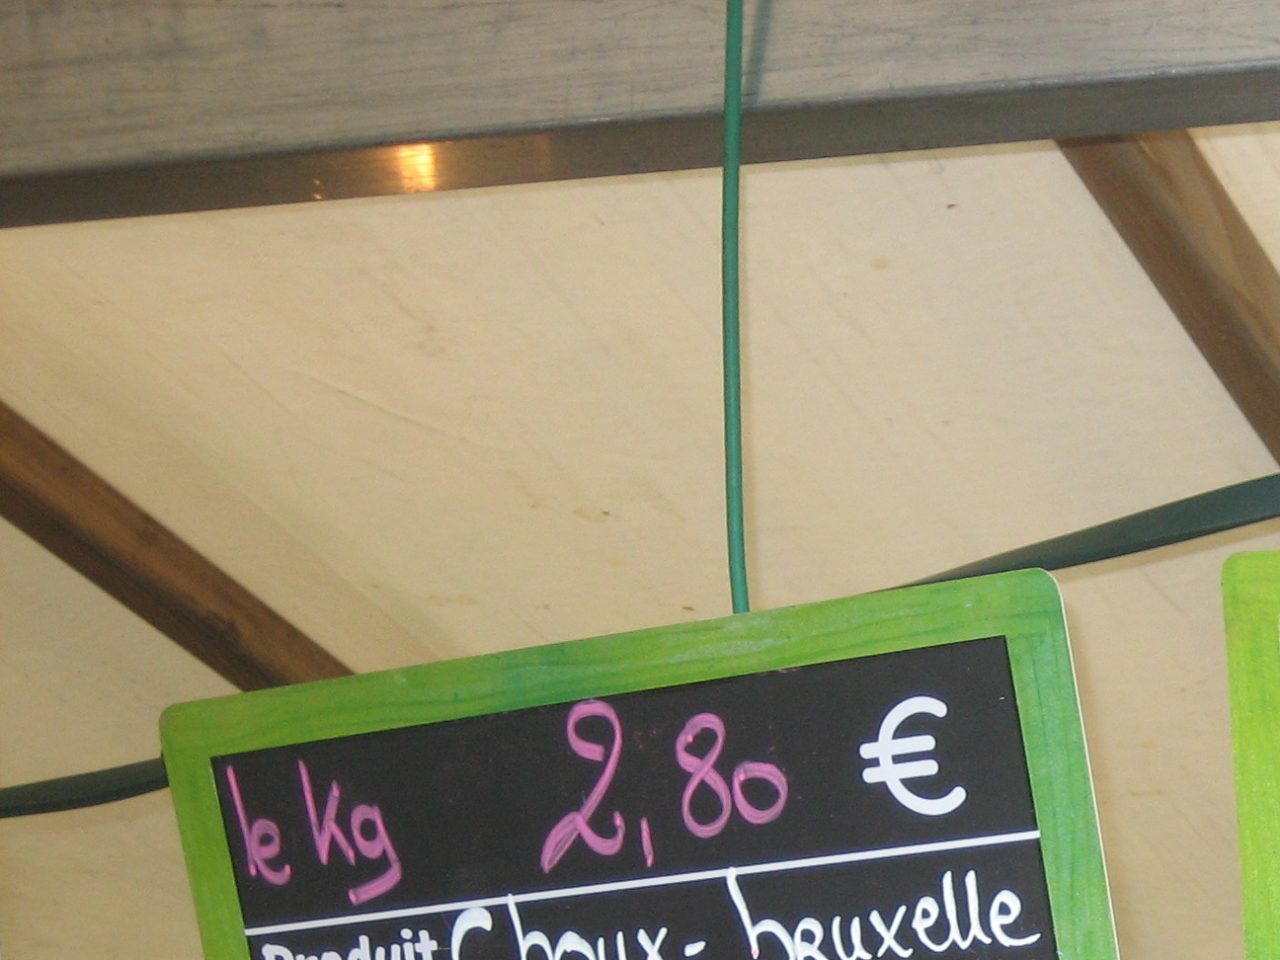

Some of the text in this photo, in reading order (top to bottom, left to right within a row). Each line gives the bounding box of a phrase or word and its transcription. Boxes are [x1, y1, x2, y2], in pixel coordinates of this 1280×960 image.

[226, 765, 291, 885] le
[540, 700, 788, 873] 2,80
[859, 695, 967, 816] €
